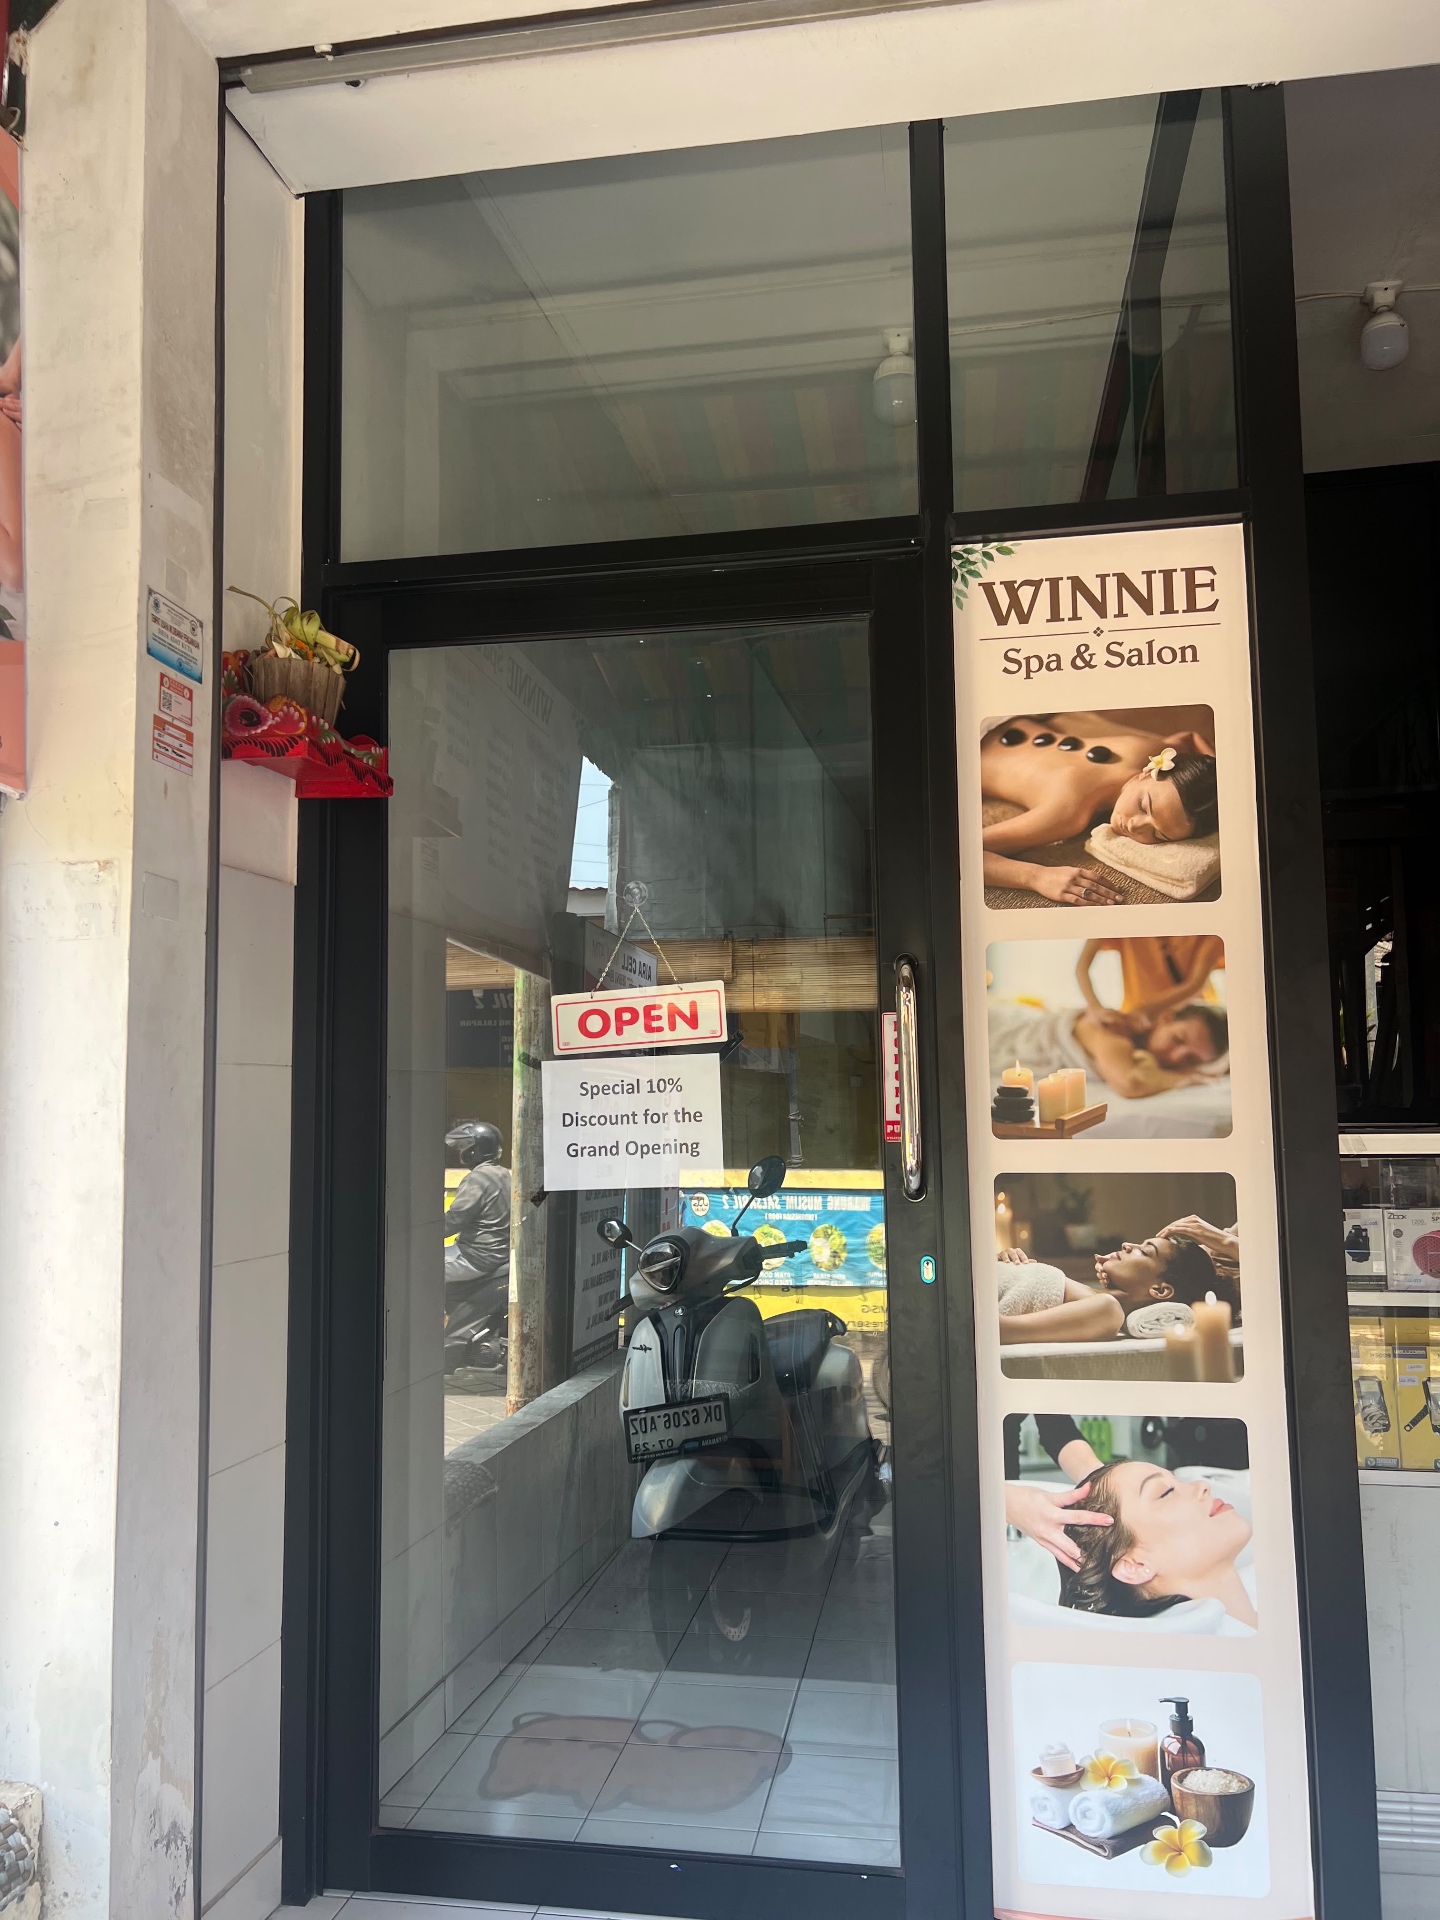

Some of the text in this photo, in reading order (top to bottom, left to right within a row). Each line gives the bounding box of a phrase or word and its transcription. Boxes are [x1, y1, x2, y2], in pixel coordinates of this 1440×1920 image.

[978, 565, 1220, 627] WINNIE
[1001, 638, 1200, 680] Spa & Salon
[577, 999, 699, 1039] OPEN
[579, 1077, 683, 1099] Special 10%
[562, 1107, 704, 1128] Discount for the
[566, 1138, 700, 1159] Grand Opening
